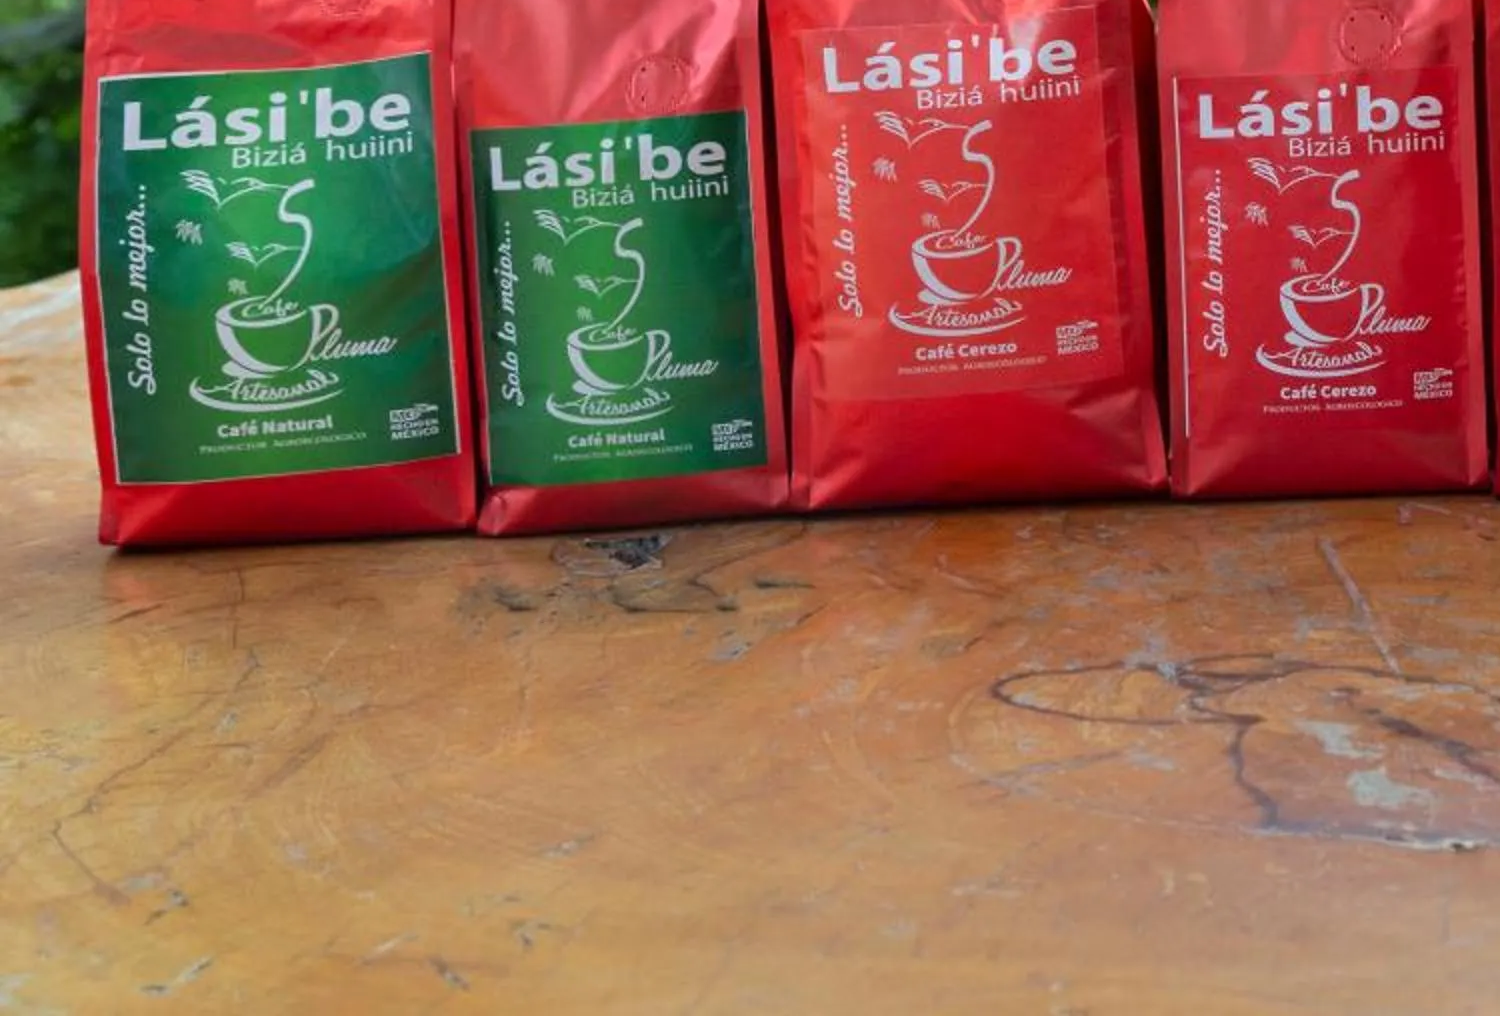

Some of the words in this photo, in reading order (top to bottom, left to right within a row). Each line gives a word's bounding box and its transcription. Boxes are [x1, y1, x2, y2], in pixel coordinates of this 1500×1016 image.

[917, 86, 984, 110] Biziá
[1001, 76, 1081, 104] huiini
[232, 144, 306, 169] Biziá
[325, 131, 413, 162] huiini
[1289, 137, 1351, 159] Biziá
[1367, 131, 1446, 155] huiini
[572, 189, 635, 209] Biziá
[651, 176, 729, 201] huiini
[832, 228, 856, 253] lo
[993, 236, 1072, 291] Pluma
[833, 261, 863, 318] Solo
[1201, 272, 1224, 296] lo
[123, 299, 149, 324] lo
[1358, 283, 1432, 335] Pluma
[305, 304, 397, 361] Pluma
[498, 321, 518, 345] lo
[1203, 301, 1228, 359] Solo
[128, 331, 157, 396] Solo
[645, 329, 719, 382] Pluma
[915, 344, 955, 361] Café
[958, 342, 1018, 357] Cerezo
[500, 351, 524, 407] Solo
[1280, 384, 1317, 400] Café
[1320, 385, 1377, 398] Cerezo
[217, 419, 257, 438] Café
[262, 414, 333, 434] Natural
[568, 433, 602, 448] Café
[606, 428, 665, 445] Natural
